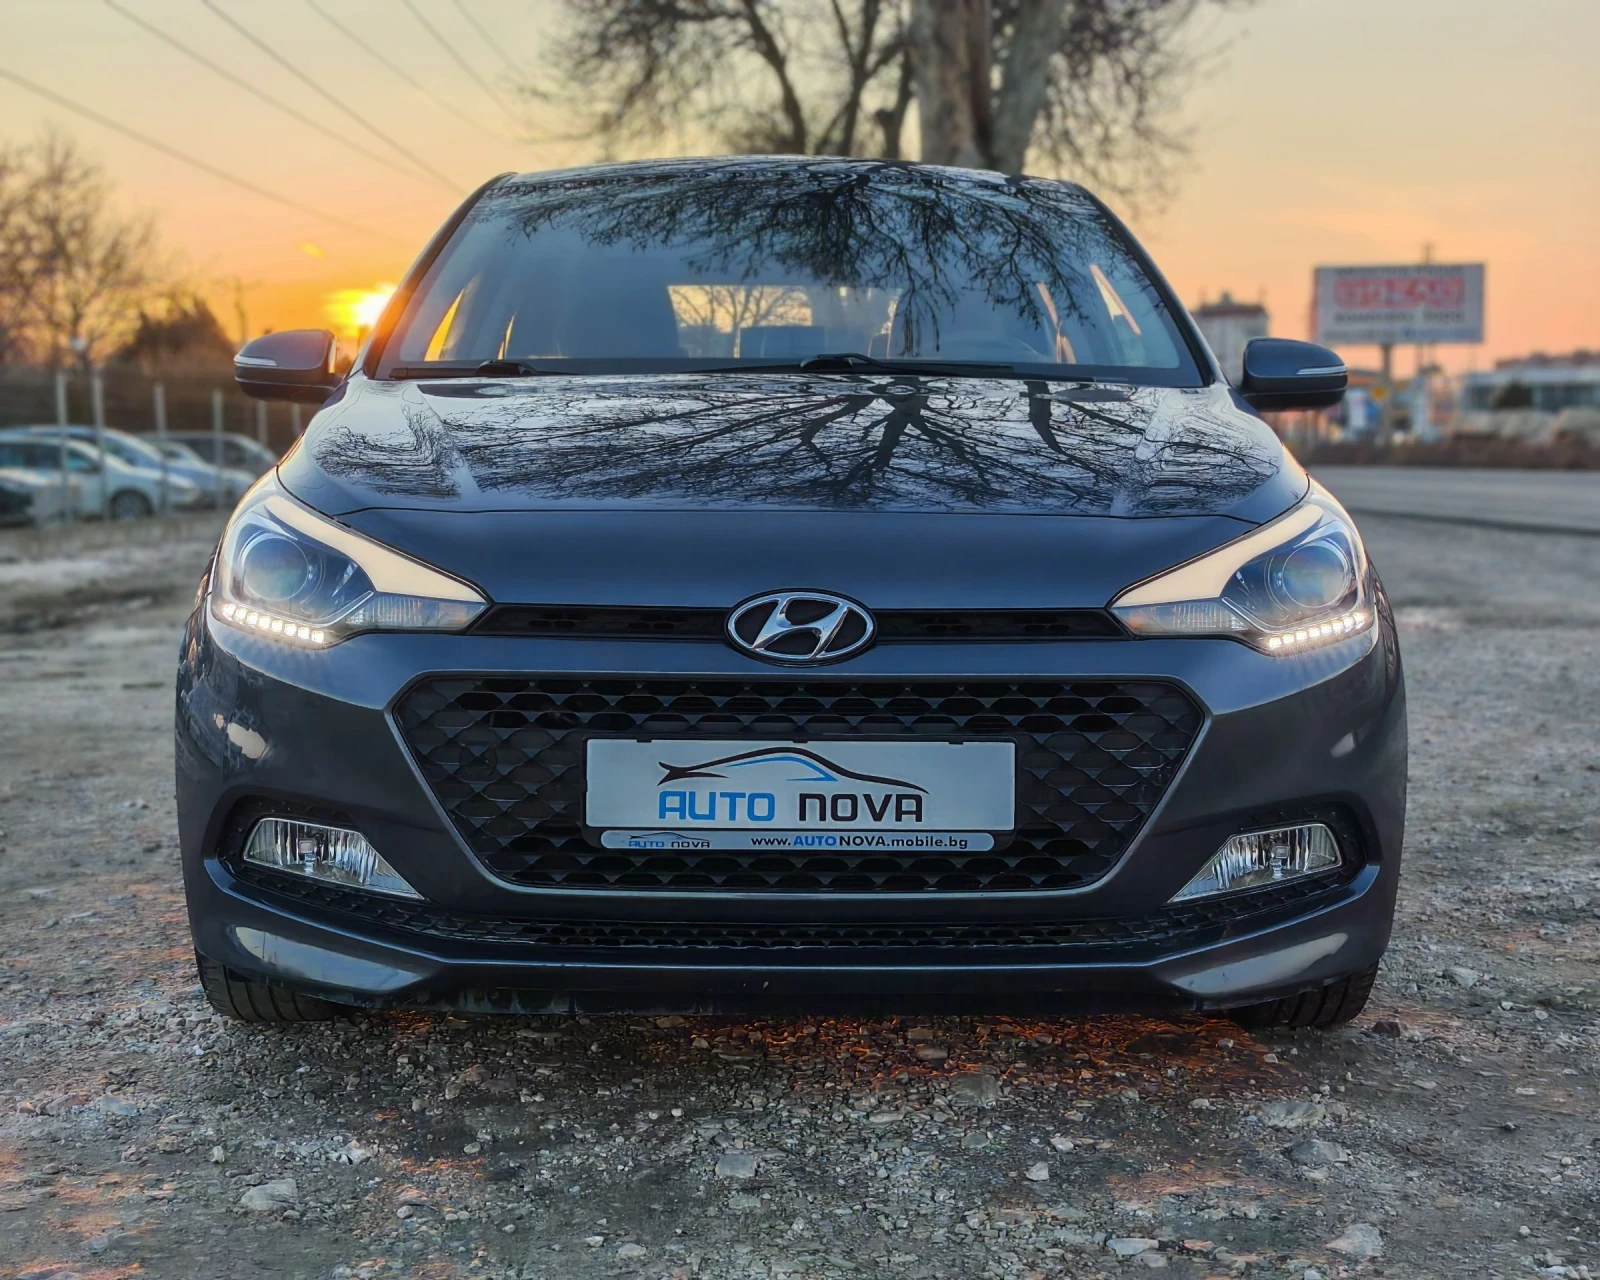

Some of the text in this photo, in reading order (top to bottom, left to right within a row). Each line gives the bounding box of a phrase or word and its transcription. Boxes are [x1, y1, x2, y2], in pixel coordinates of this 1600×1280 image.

[658, 790, 923, 823] AUTO NOVA
[628, 840, 665, 848] AUTO
[750, 835, 968, 850] www.AUTONOVA.mobile.bg
